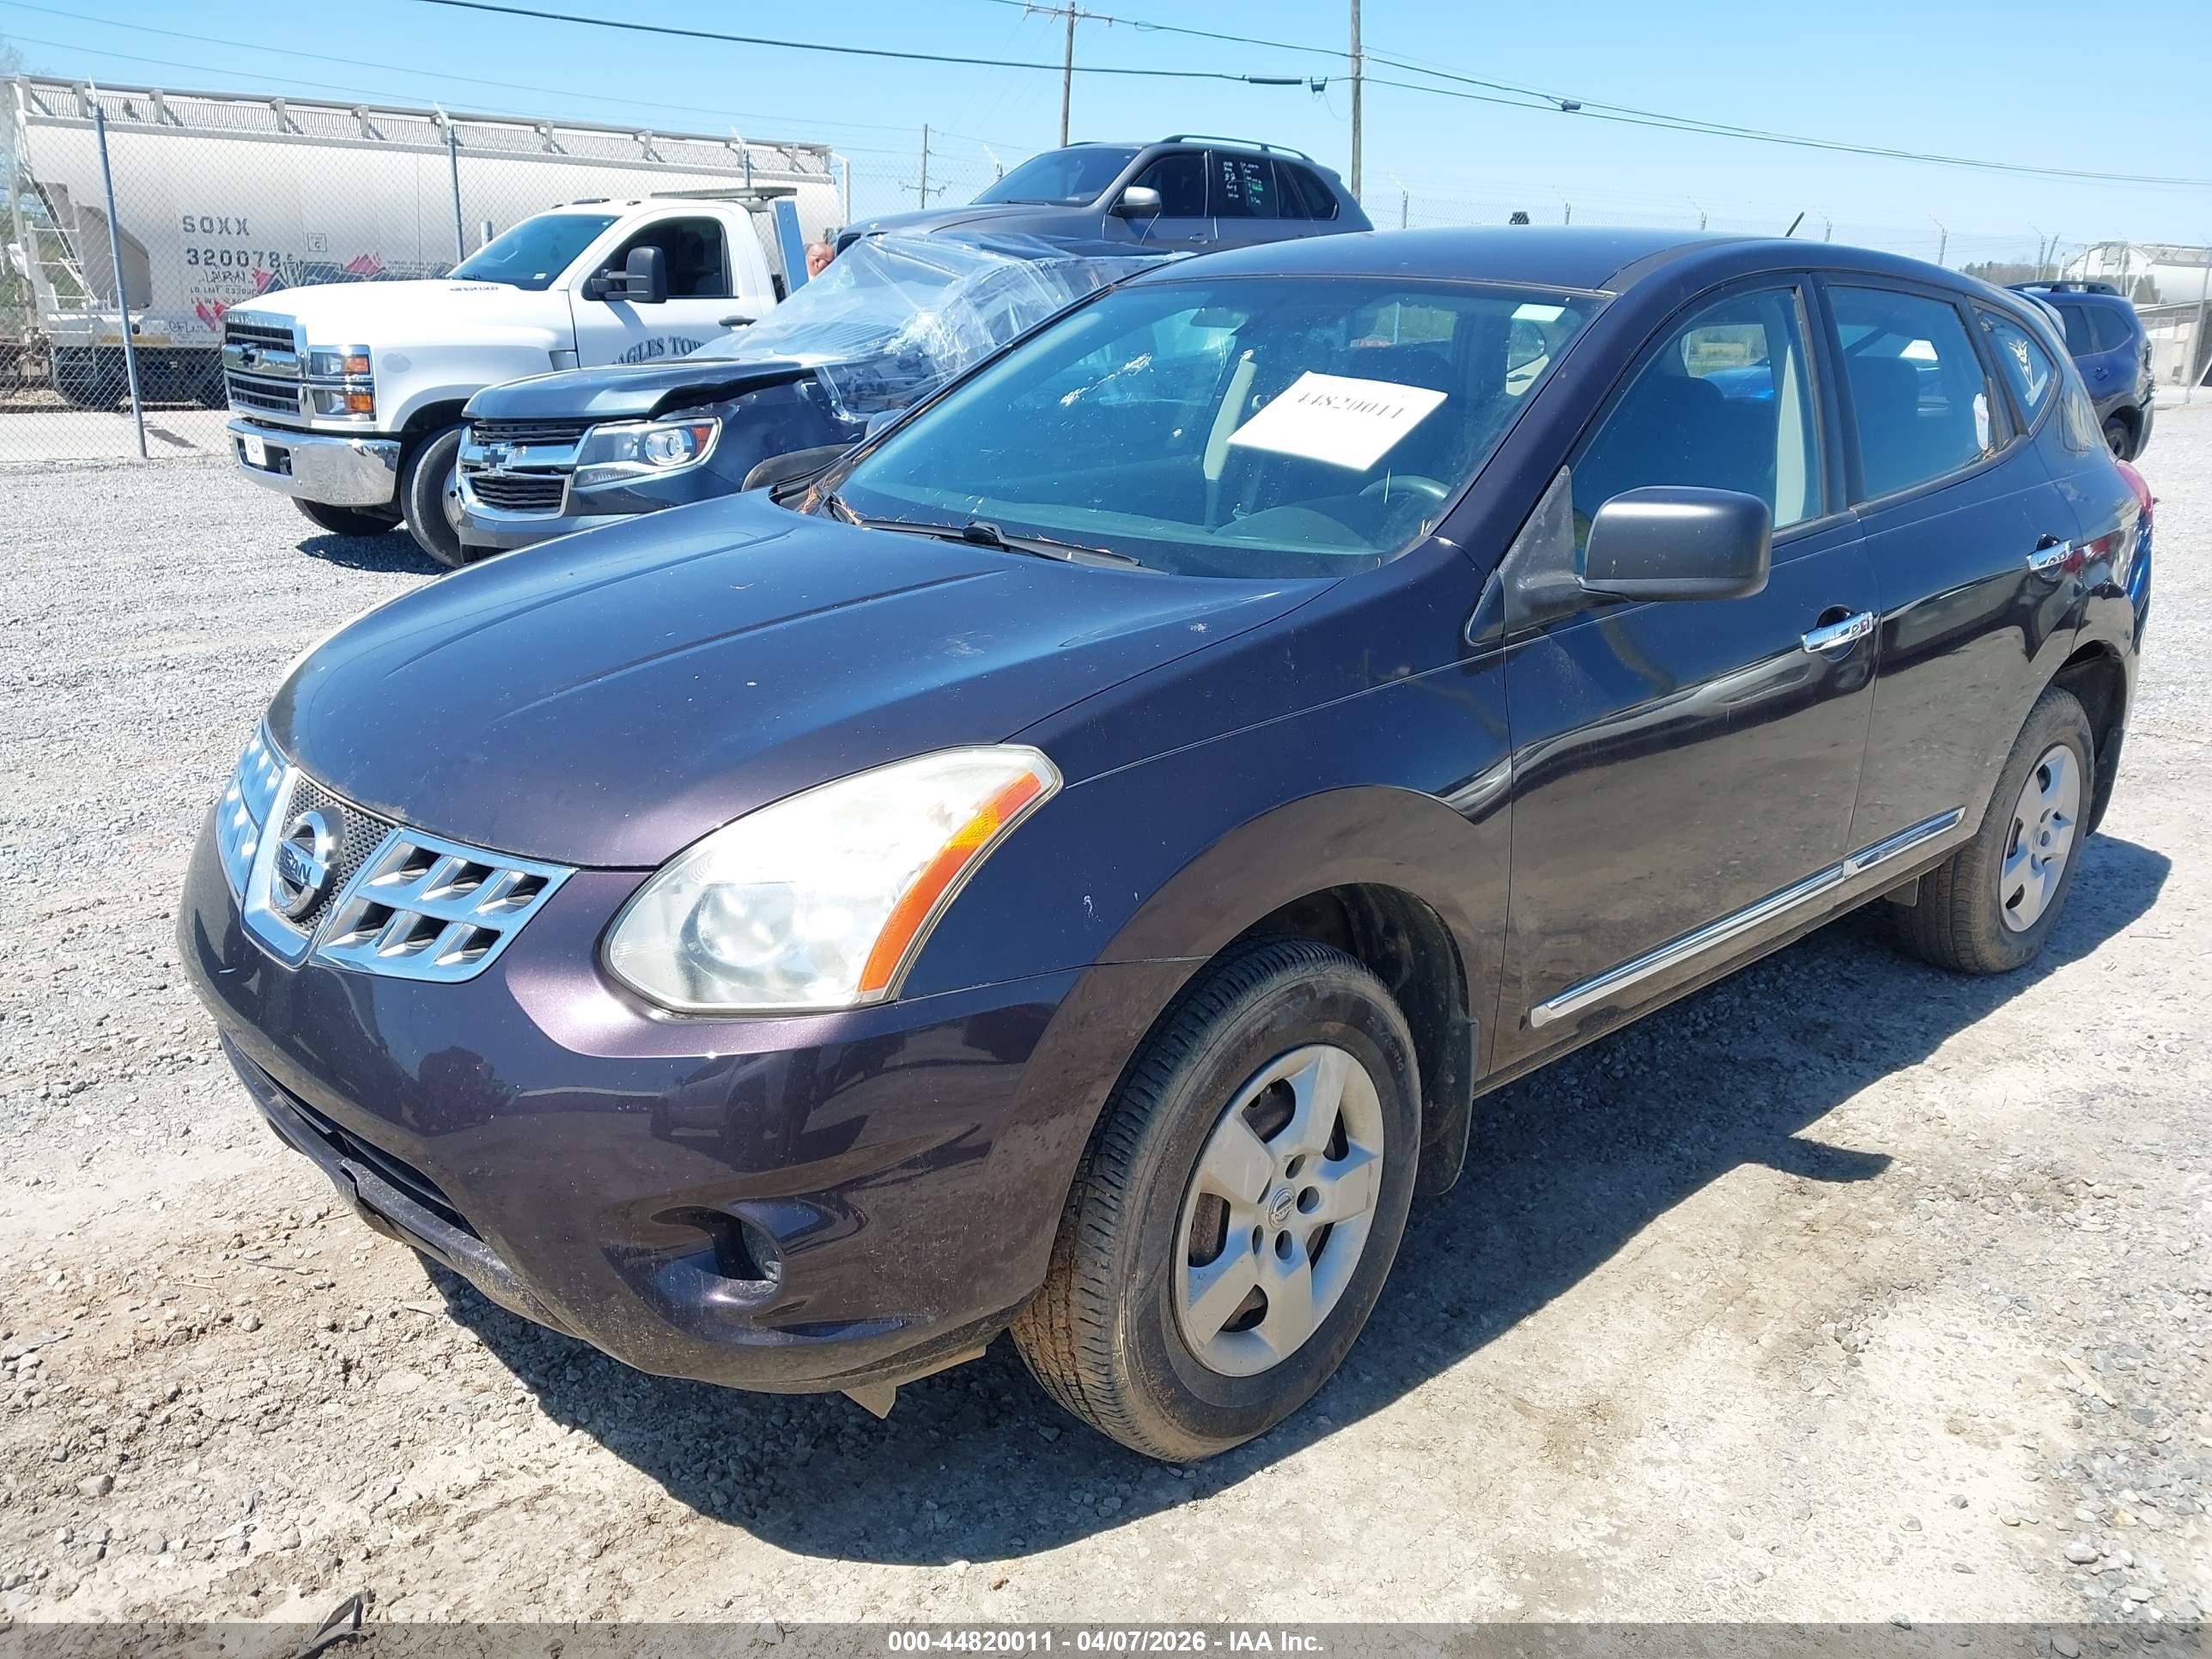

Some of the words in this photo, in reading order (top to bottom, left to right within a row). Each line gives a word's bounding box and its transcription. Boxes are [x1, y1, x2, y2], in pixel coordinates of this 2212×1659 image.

[182, 216, 250, 236] SOXX
[186, 247, 281, 270] 320078
[611, 337, 665, 364] AGLES
